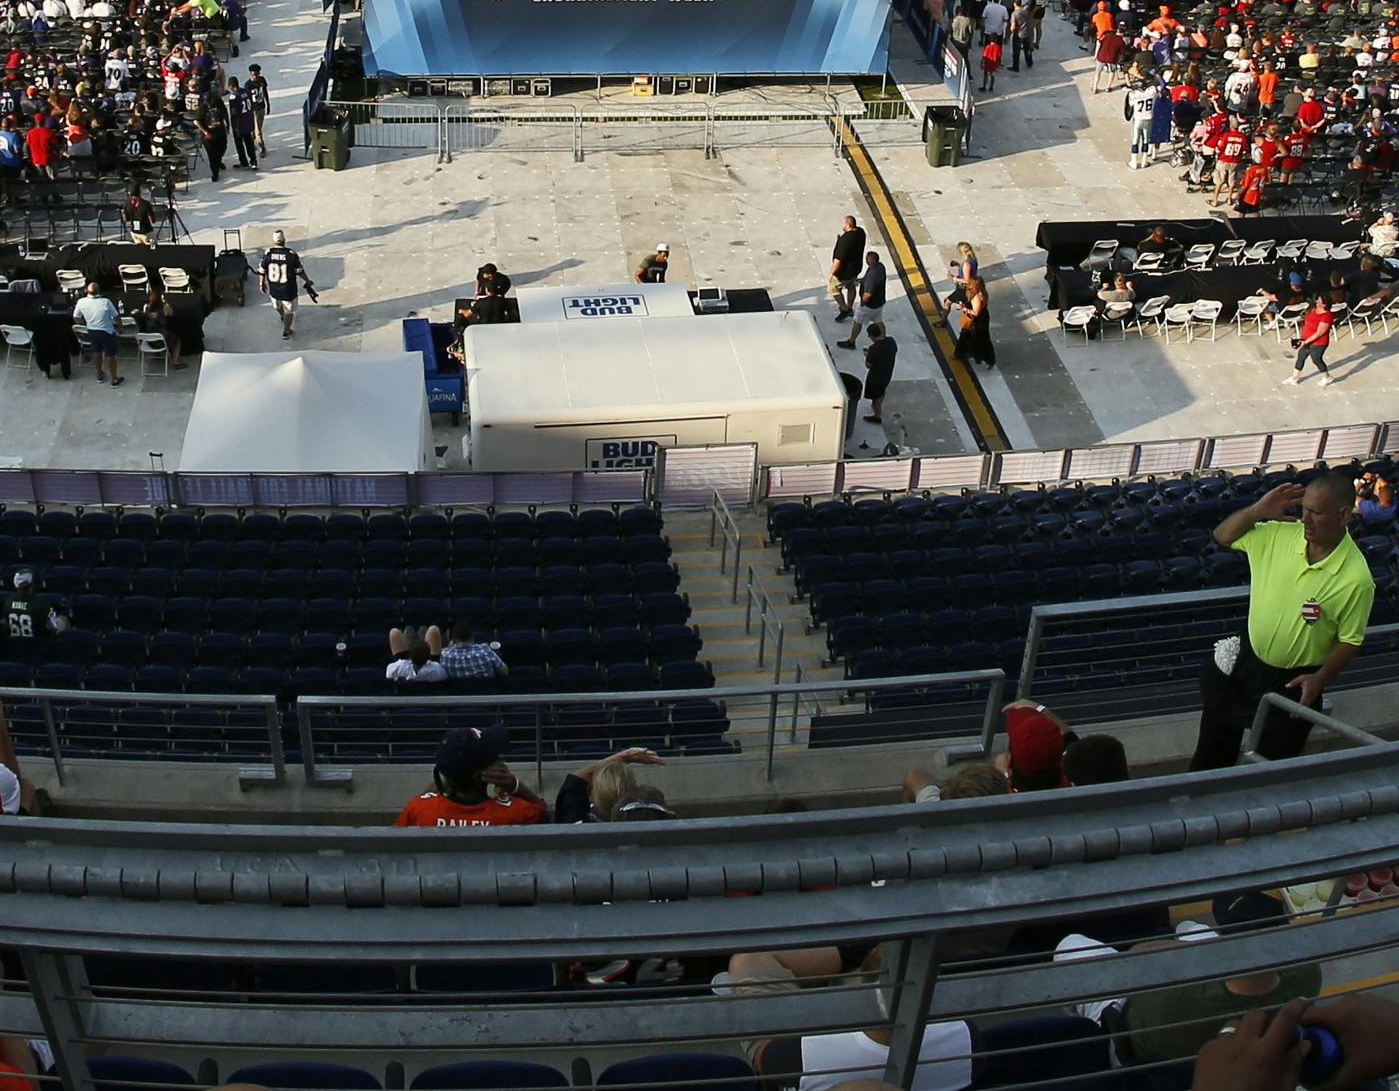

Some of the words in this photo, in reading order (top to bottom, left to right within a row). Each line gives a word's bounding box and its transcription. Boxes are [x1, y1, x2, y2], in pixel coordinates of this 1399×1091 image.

[1136, 98, 1153, 113] 76
[1224, 143, 1241, 156] 89
[267, 263, 288, 284] 81
[570, 297, 642, 308] LIGHT
[581, 306, 634, 316] BUD
[602, 440, 658, 459] BUD
[8, 612, 34, 637] 68
